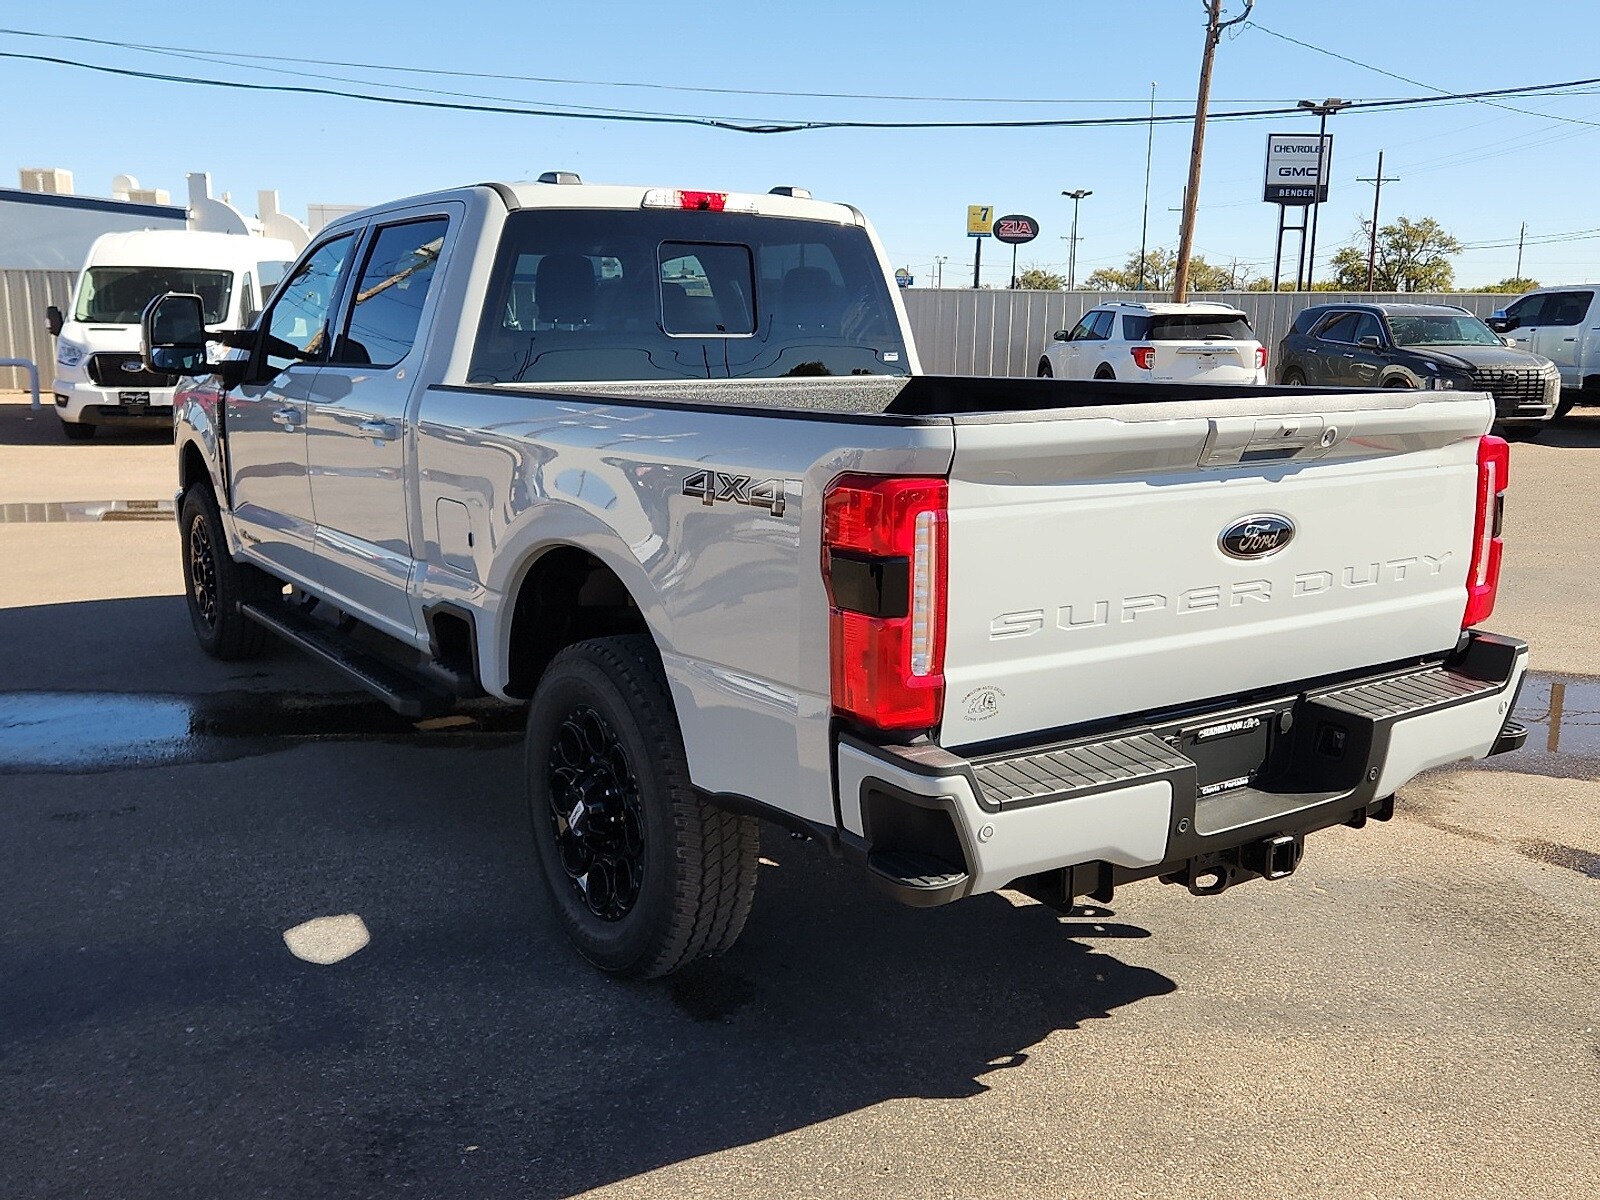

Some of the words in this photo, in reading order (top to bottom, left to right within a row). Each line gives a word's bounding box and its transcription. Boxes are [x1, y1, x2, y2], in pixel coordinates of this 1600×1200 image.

[1278, 167, 1318, 176] GMC
[1278, 188, 1314, 197] BENDER
[981, 207, 989, 222] 7
[999, 220, 1034, 234] ZIA
[1238, 523, 1281, 552] Ford
[989, 578, 1272, 642] SUPER
[1293, 551, 1453, 598] DUTY
[1203, 720, 1244, 737] HAMILTON
